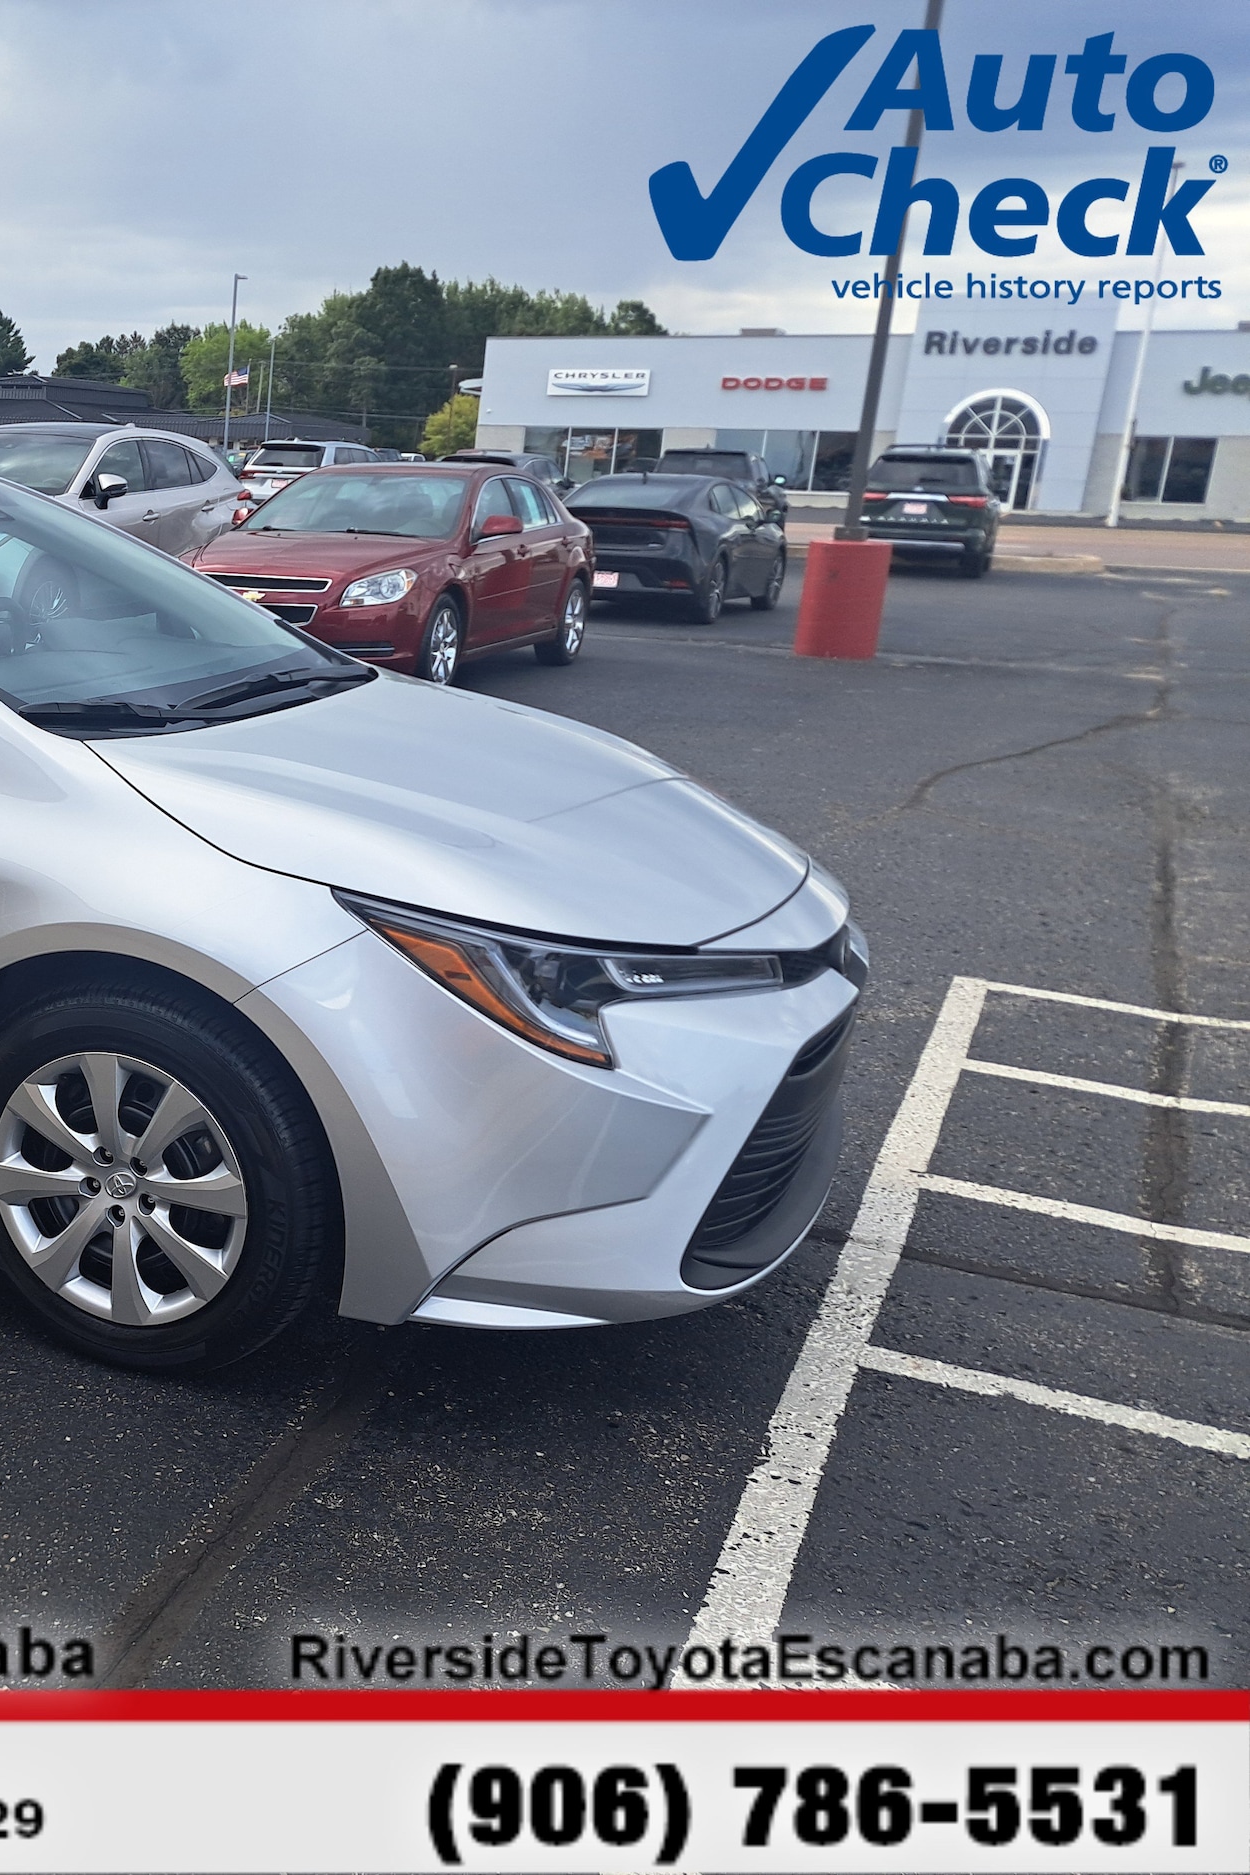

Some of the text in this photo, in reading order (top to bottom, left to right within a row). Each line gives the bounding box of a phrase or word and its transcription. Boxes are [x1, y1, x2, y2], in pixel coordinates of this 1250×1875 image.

[924, 329, 1098, 356] Riverside
[553, 372, 647, 380] CHRYSLER
[721, 377, 828, 391] DODGE
[1183, 366, 1250, 397] Jee
